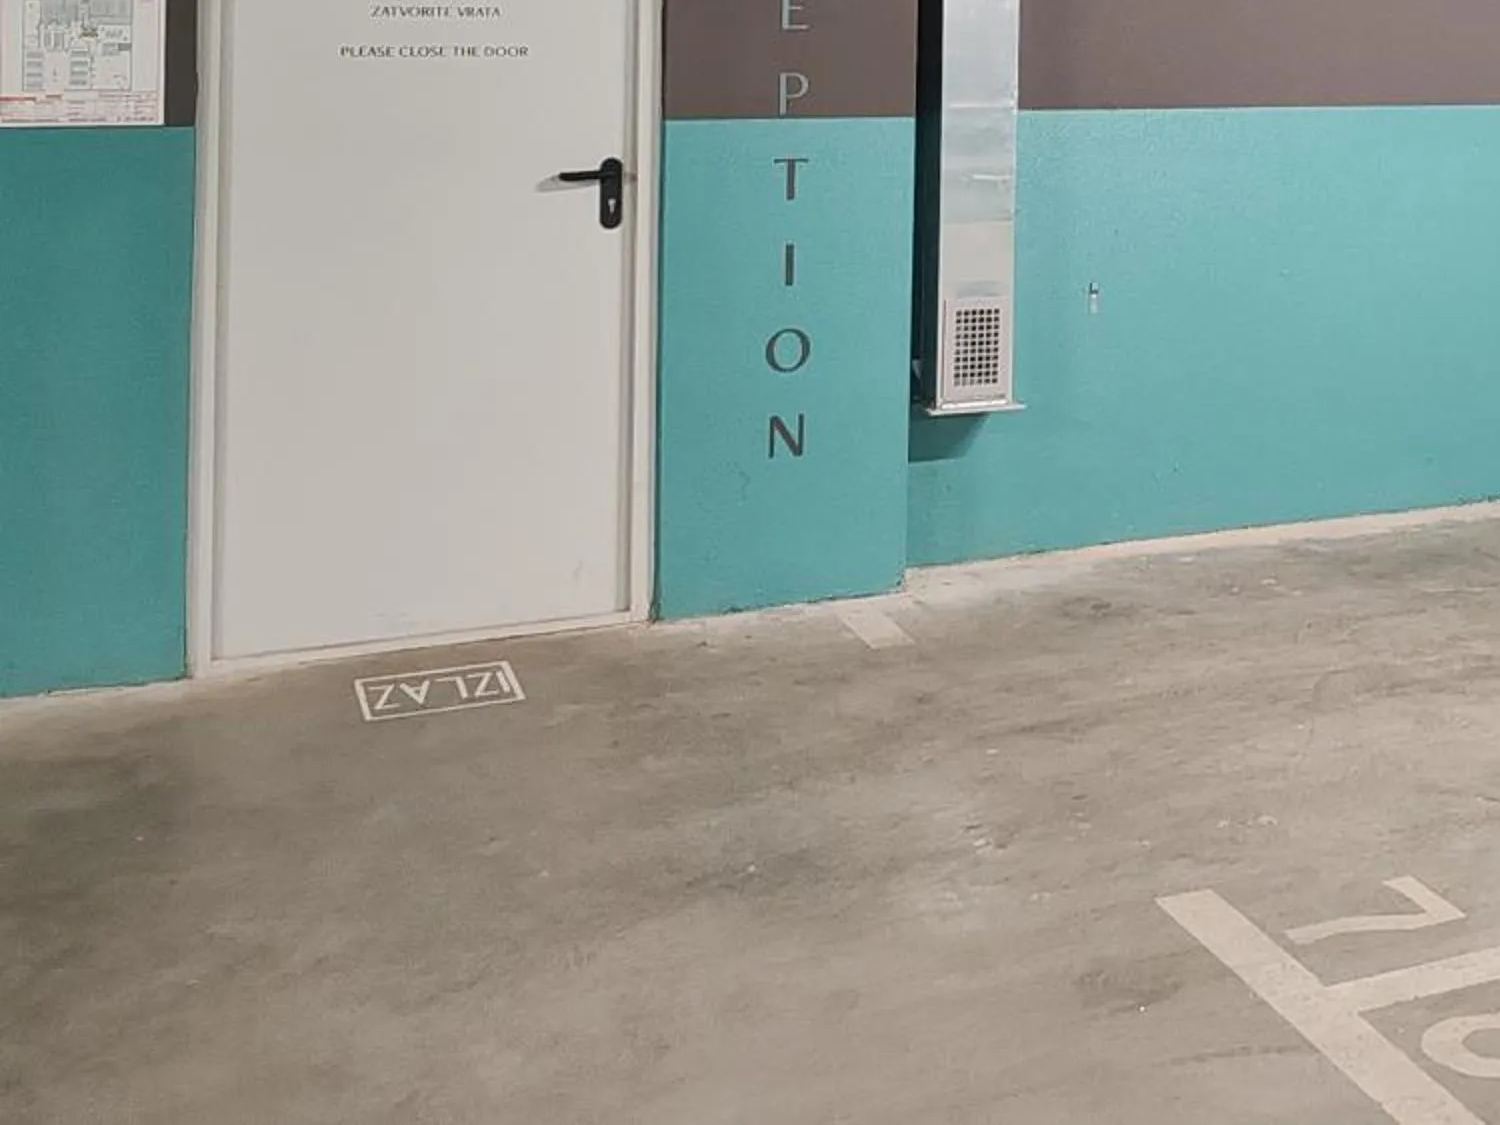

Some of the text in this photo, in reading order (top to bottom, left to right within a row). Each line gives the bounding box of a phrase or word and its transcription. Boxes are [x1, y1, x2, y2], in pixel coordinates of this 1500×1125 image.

[370, 5, 501, 18] ZATVORITE VRATA
[339, 44, 530, 58] PLEASE CLOSE THE DOOR
[367, 671, 511, 711] IZLAZ
[1285, 875, 1467, 945] 7
